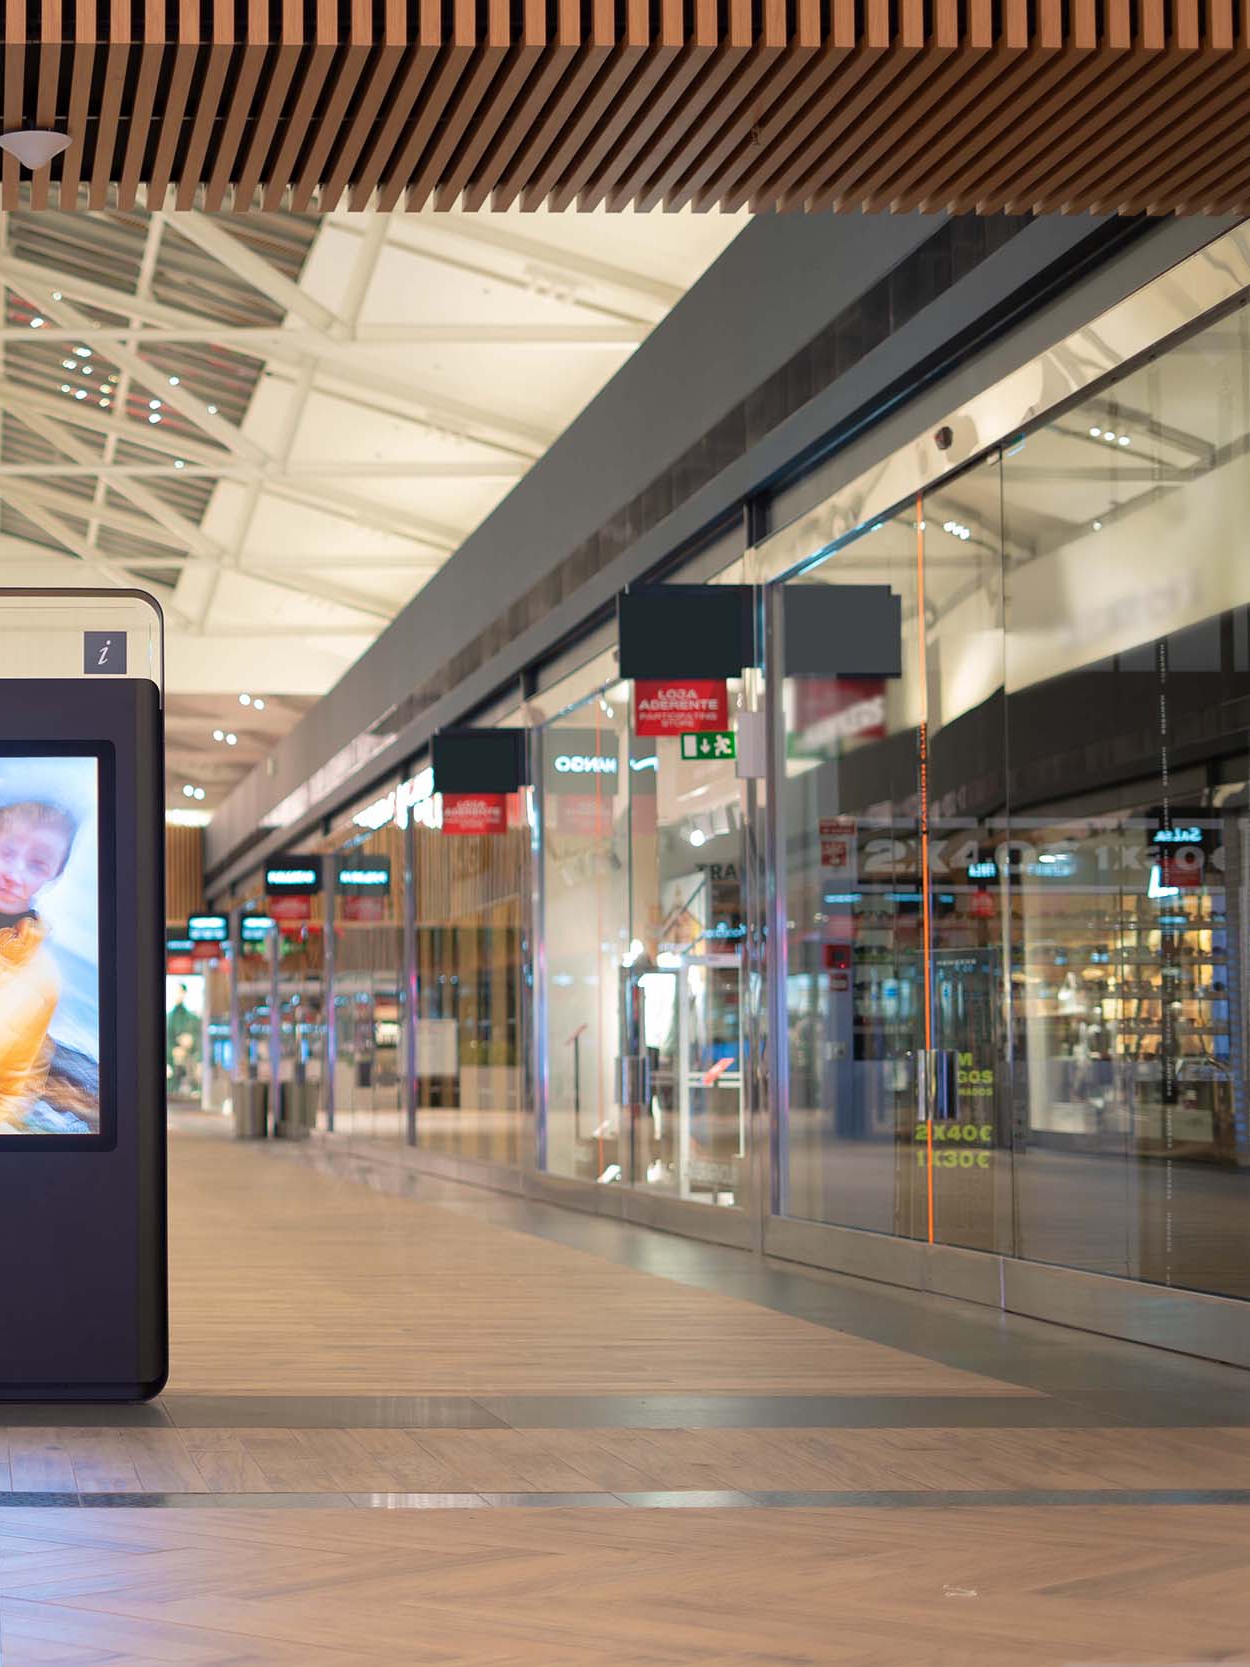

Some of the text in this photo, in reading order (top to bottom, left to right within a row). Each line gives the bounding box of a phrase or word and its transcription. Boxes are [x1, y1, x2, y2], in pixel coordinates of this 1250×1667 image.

[657, 688, 698, 699] LOJA
[638, 699, 719, 711] ADERENTE
[915, 1124, 993, 1141] 2X40€
